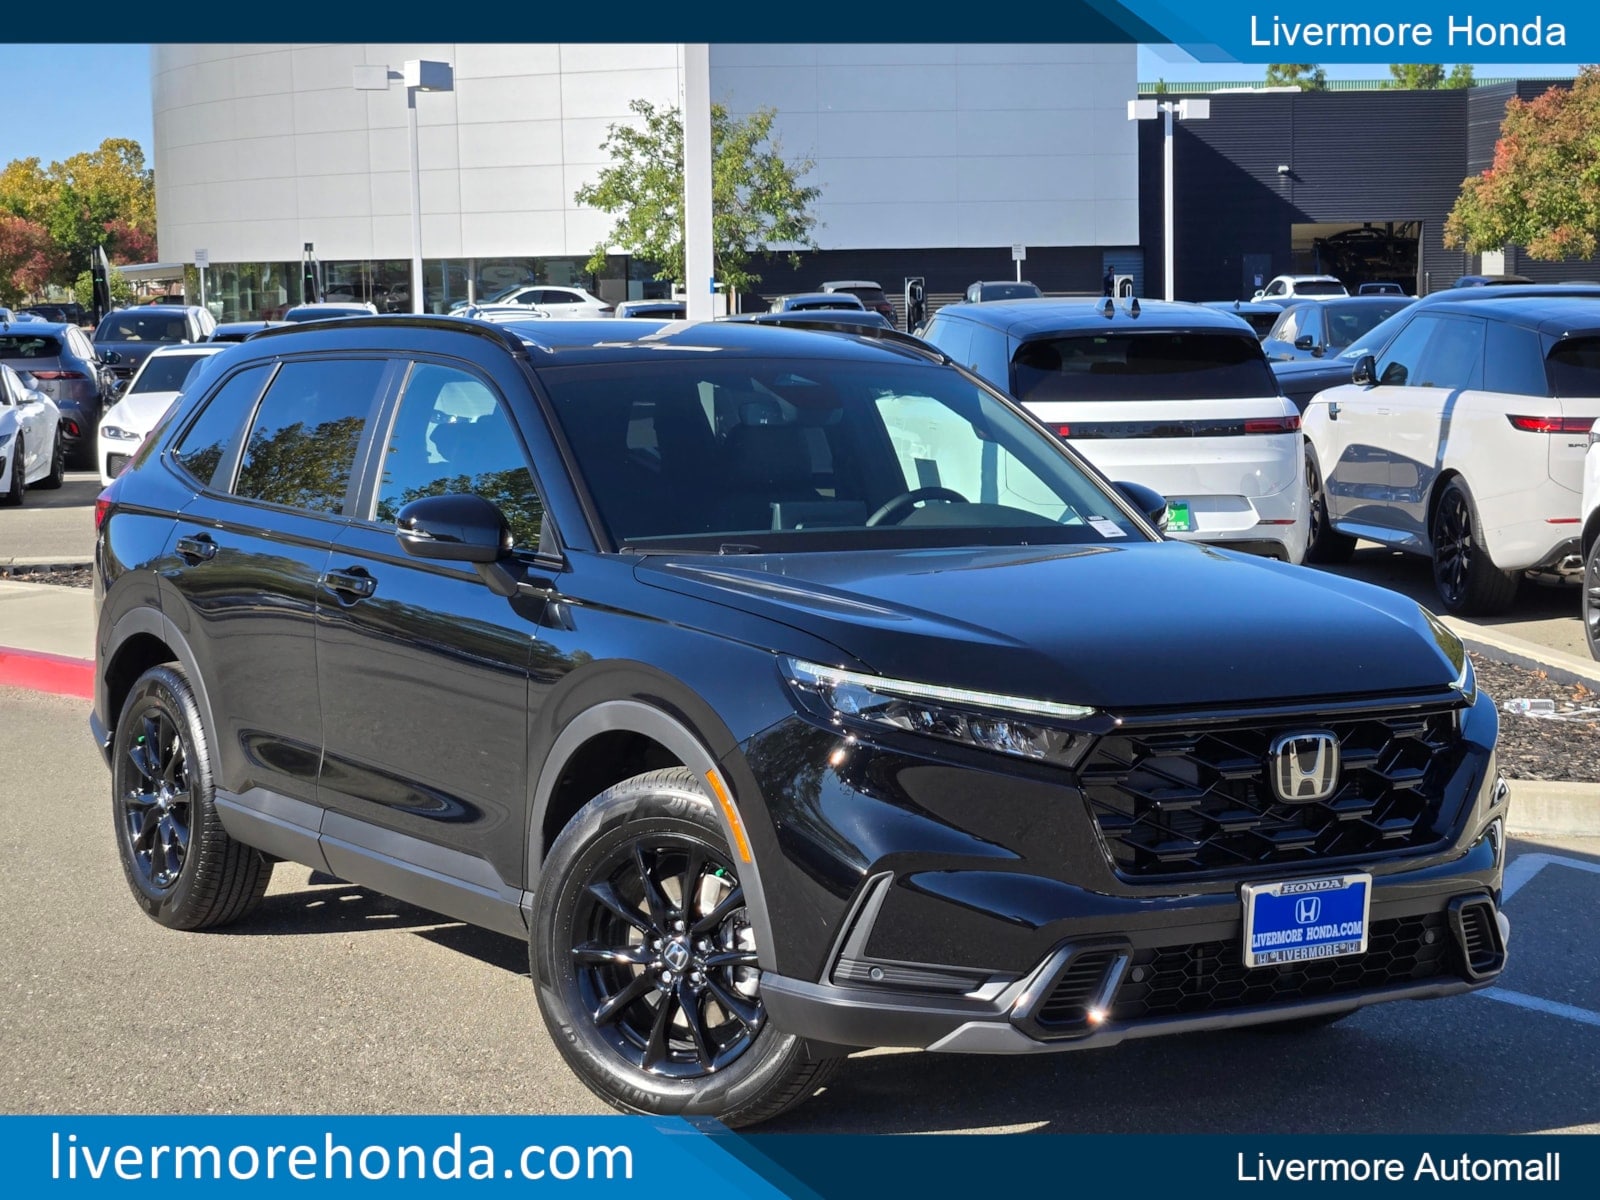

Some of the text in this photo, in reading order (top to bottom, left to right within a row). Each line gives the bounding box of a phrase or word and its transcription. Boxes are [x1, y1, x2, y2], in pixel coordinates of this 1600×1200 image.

[1282, 880, 1341, 894] HONDA
[1252, 920, 1362, 948] LIVERMORE HONDA.COM
[1275, 944, 1340, 962] LIVERMORE
